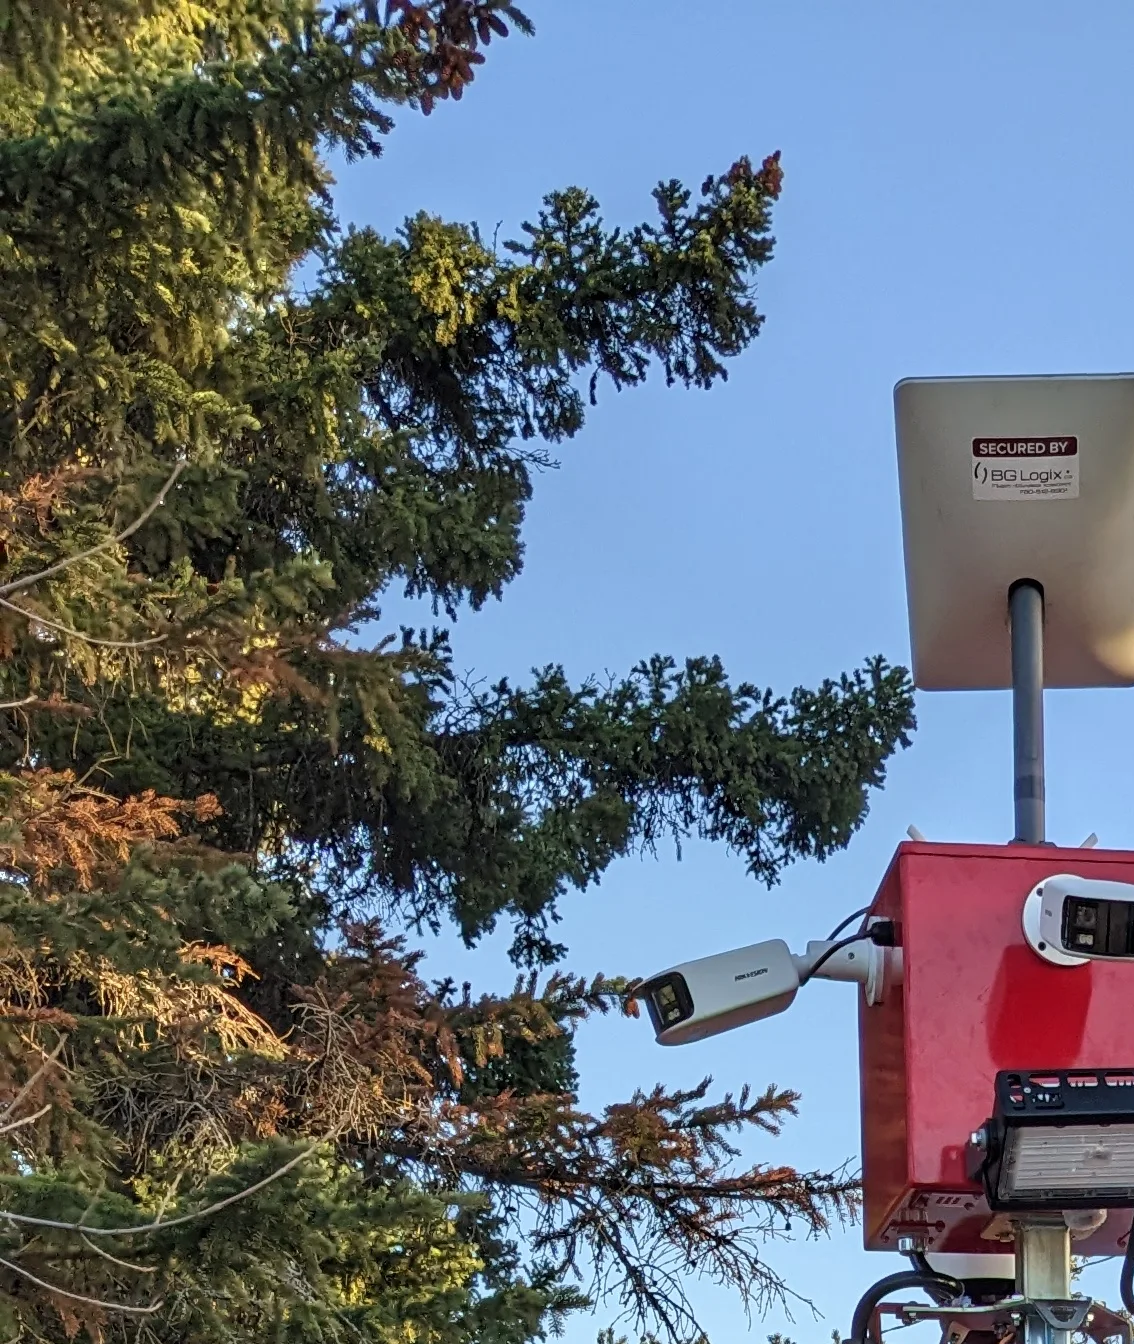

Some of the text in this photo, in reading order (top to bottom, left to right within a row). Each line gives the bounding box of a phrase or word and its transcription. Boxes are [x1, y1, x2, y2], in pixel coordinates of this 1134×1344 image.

[979, 441, 1069, 455] SECURED BY
[991, 469, 1017, 482] BG
[1020, 468, 1062, 483] Logix
[734, 967, 769, 982] HIKVISION
